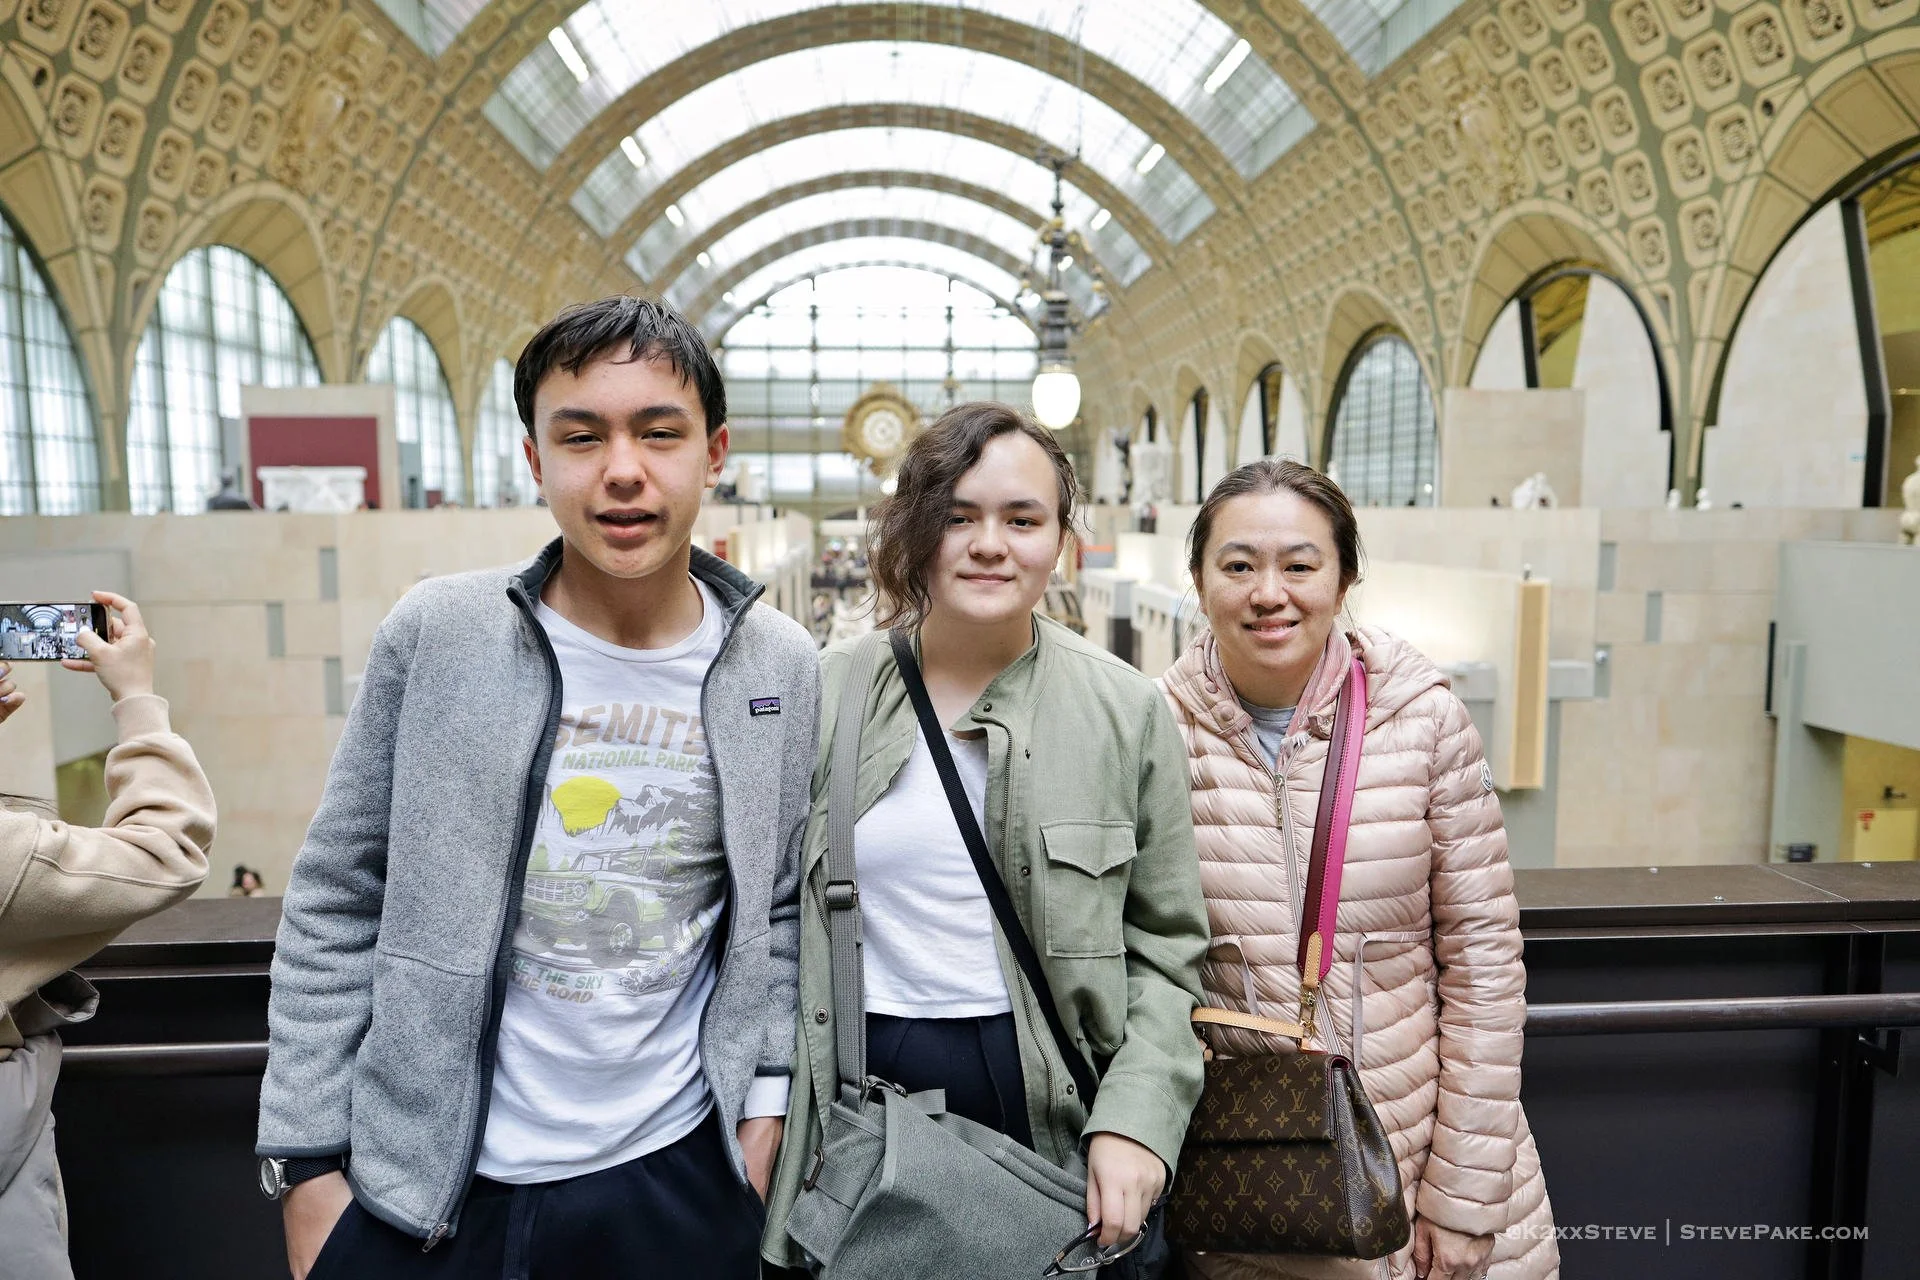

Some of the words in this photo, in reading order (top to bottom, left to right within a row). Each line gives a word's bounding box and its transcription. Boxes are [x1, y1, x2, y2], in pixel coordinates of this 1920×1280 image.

[562, 749, 650, 770] NATIONAL
[655, 751, 699, 773] PARK
[537, 966, 569, 985] THE
[575, 975, 604, 989] SKY
[545, 982, 595, 1004] ROAD
